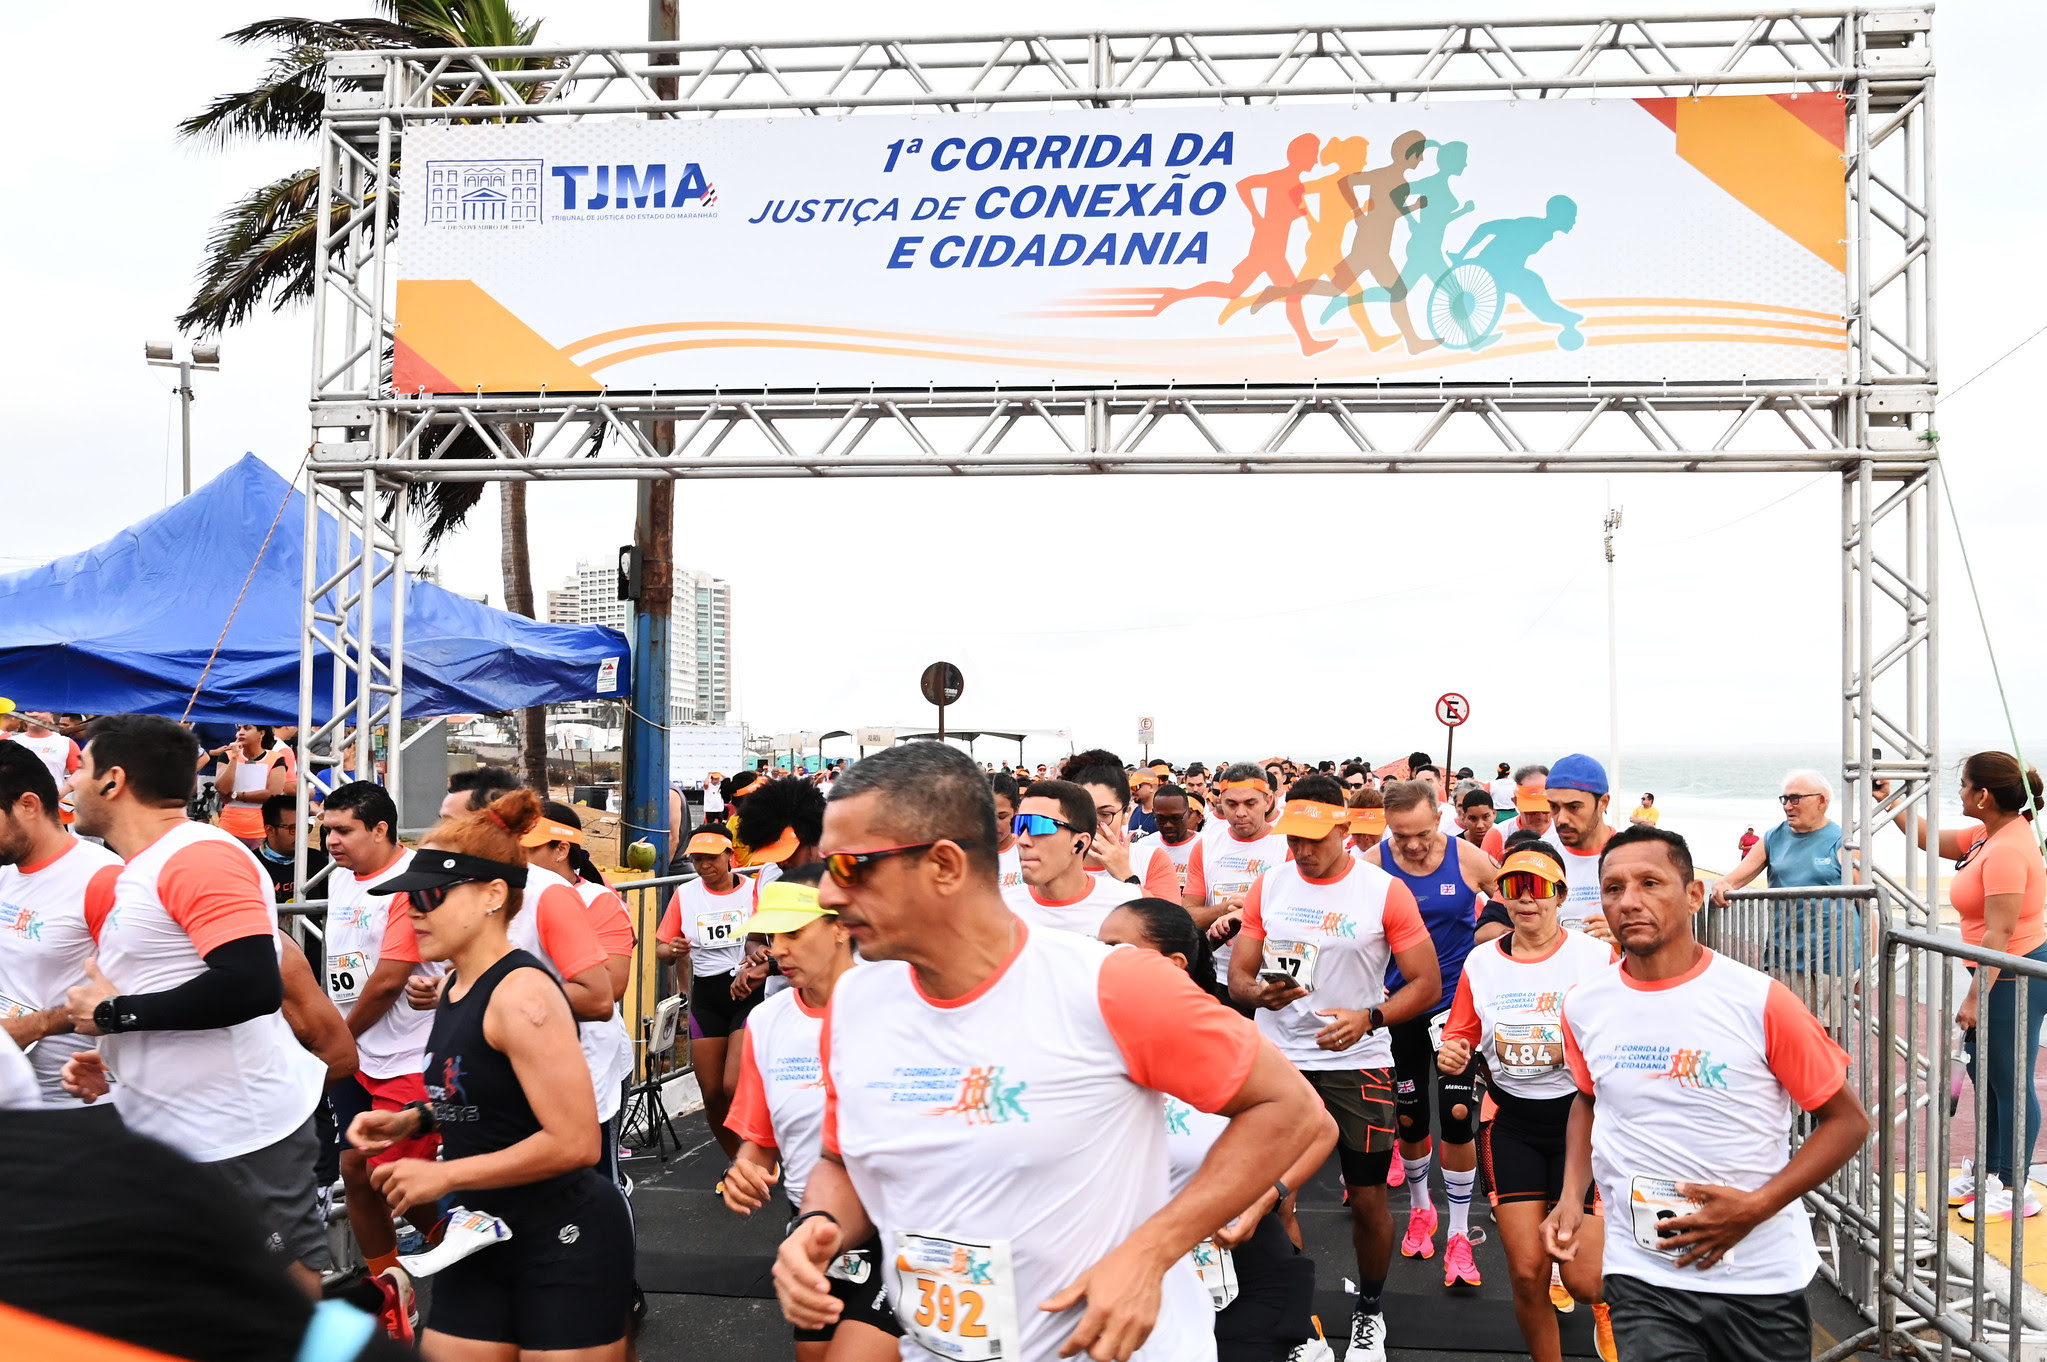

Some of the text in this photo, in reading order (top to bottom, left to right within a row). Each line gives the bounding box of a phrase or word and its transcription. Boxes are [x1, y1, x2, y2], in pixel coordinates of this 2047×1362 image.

[883, 131, 1235, 173] 1ª CORRIDA DA
[551, 162, 710, 210] TJMA
[748, 173, 1227, 227] JUSTIÇA DE CONEXÃO
[886, 231, 1209, 270] E CIDADANIA
[1447, 701, 1459, 719] E
[1278, 958, 1301, 977] 17
[330, 972, 354, 992] 50
[1504, 1044, 1552, 1065] 484
[1628, 1053, 1669, 1061] CONEXÃO
[903, 1068, 947, 1077] CORRIDA
[949, 1067, 963, 1077] DA
[900, 1093, 955, 1102] CIDADANIA
[914, 1278, 988, 1336] 392
